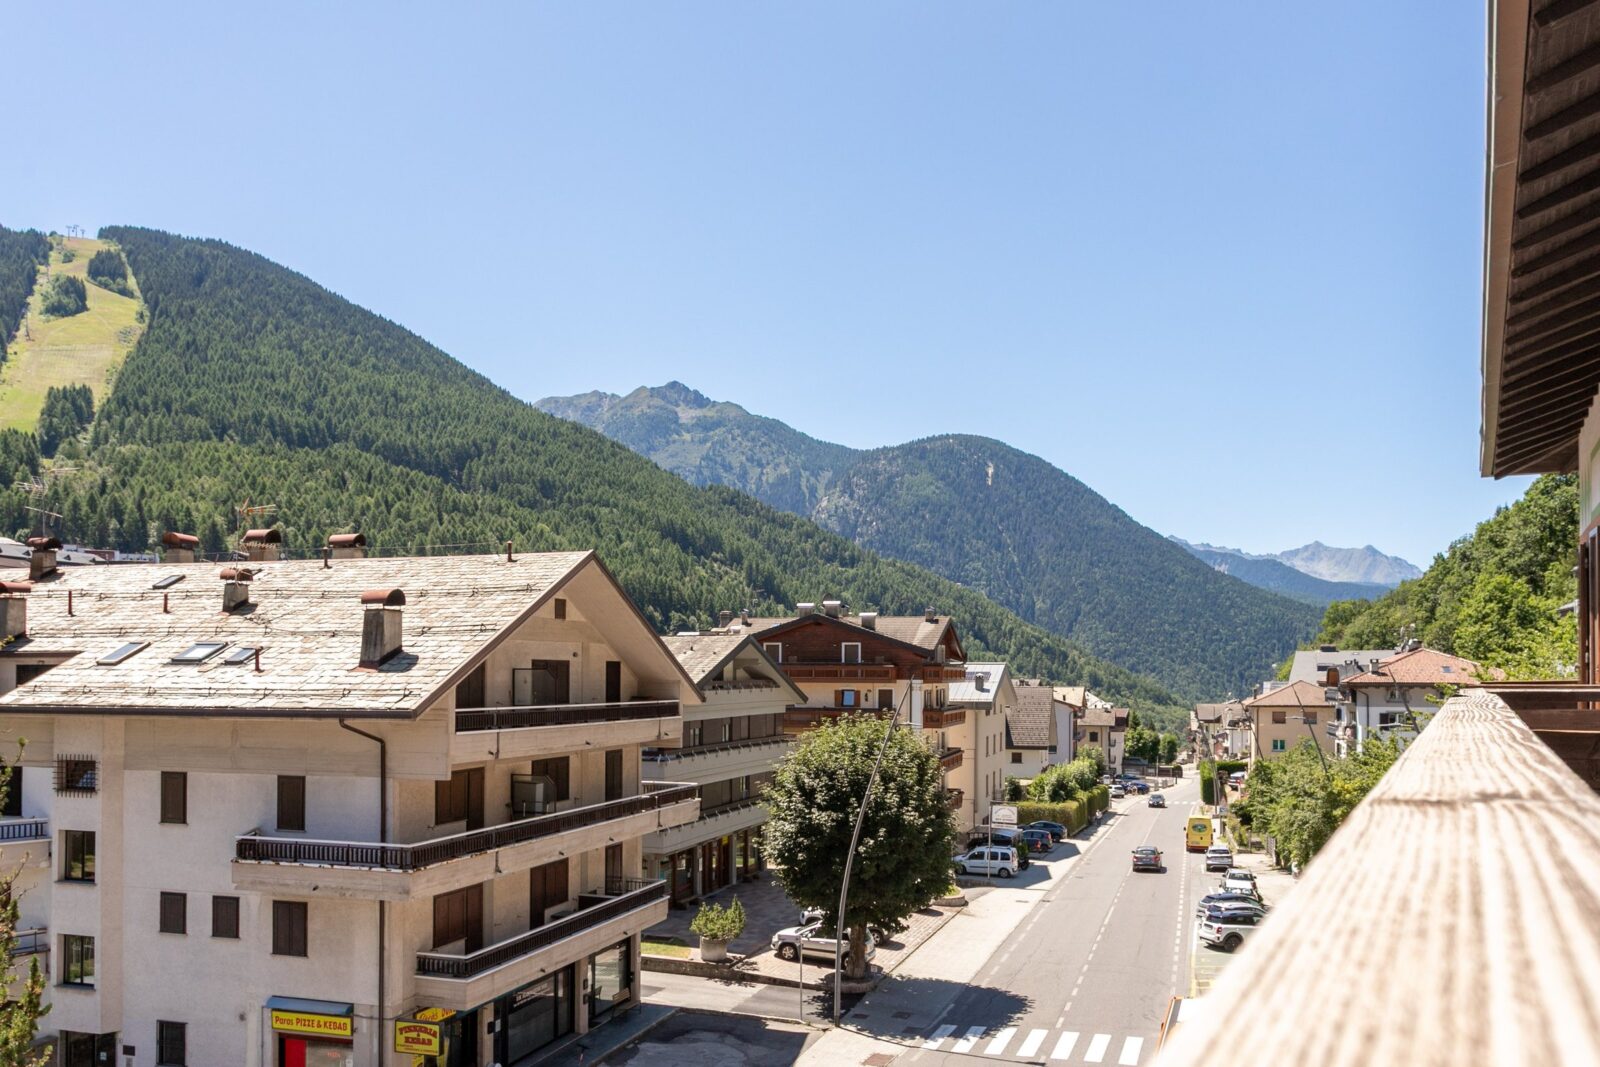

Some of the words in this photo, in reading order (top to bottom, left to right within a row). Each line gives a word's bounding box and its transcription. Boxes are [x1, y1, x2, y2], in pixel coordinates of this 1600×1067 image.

[274, 1016, 294, 1025] Paros
[295, 1018, 316, 1028] PIZZE
[316, 1020, 322, 1028] &
[324, 1021, 348, 1031] KEBAB
[399, 1025, 438, 1039] PIZZERIA
[404, 1036, 433, 1046] KEBAB
